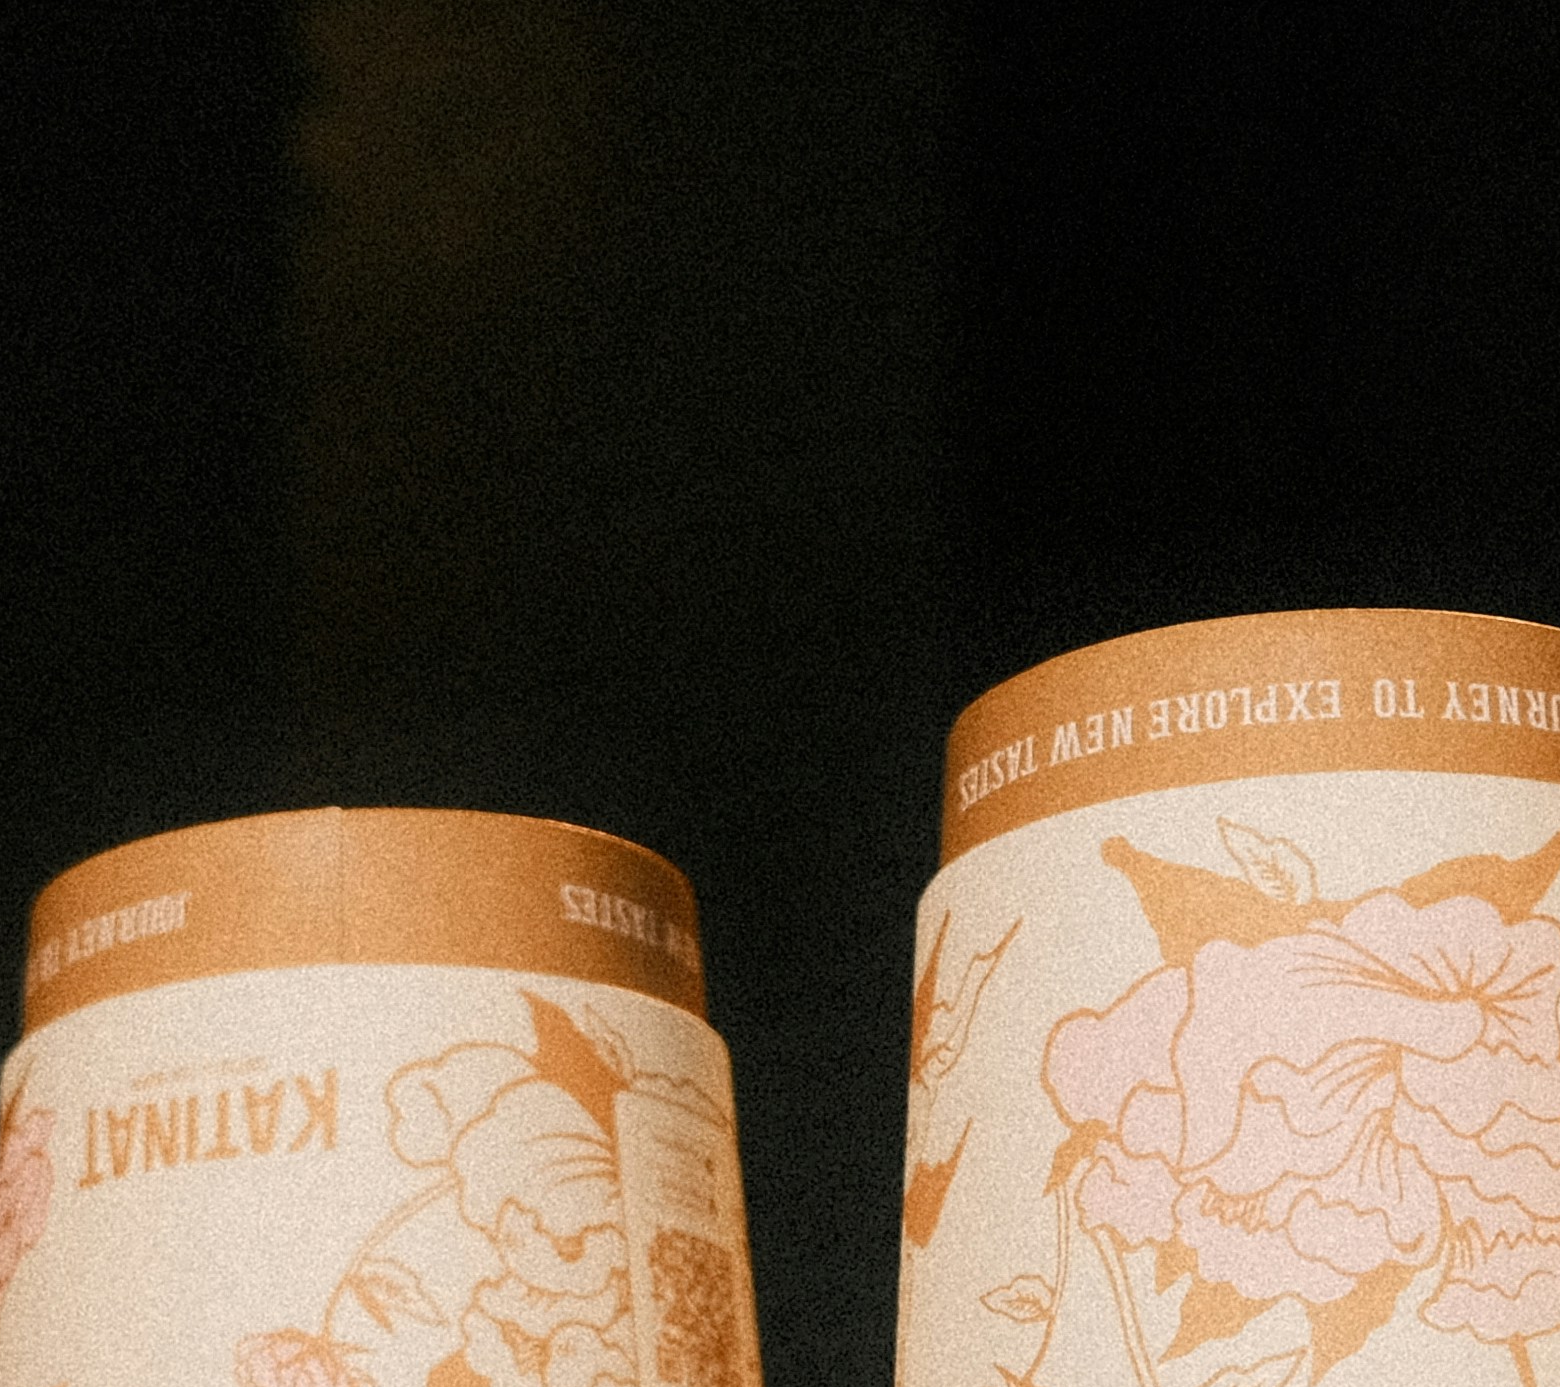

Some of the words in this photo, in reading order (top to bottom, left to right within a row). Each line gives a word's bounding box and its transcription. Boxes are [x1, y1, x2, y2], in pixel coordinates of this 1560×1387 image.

[1149, 680, 1341, 741] EXPLORE
[1373, 679, 1424, 719] TO
[1051, 705, 1133, 766] NEW
[959, 737, 1038, 811] TASTES
[67, 891, 191, 966] JOURNEY
[561, 884, 658, 946] TASTES
[79, 1068, 339, 1189] KATINAT
